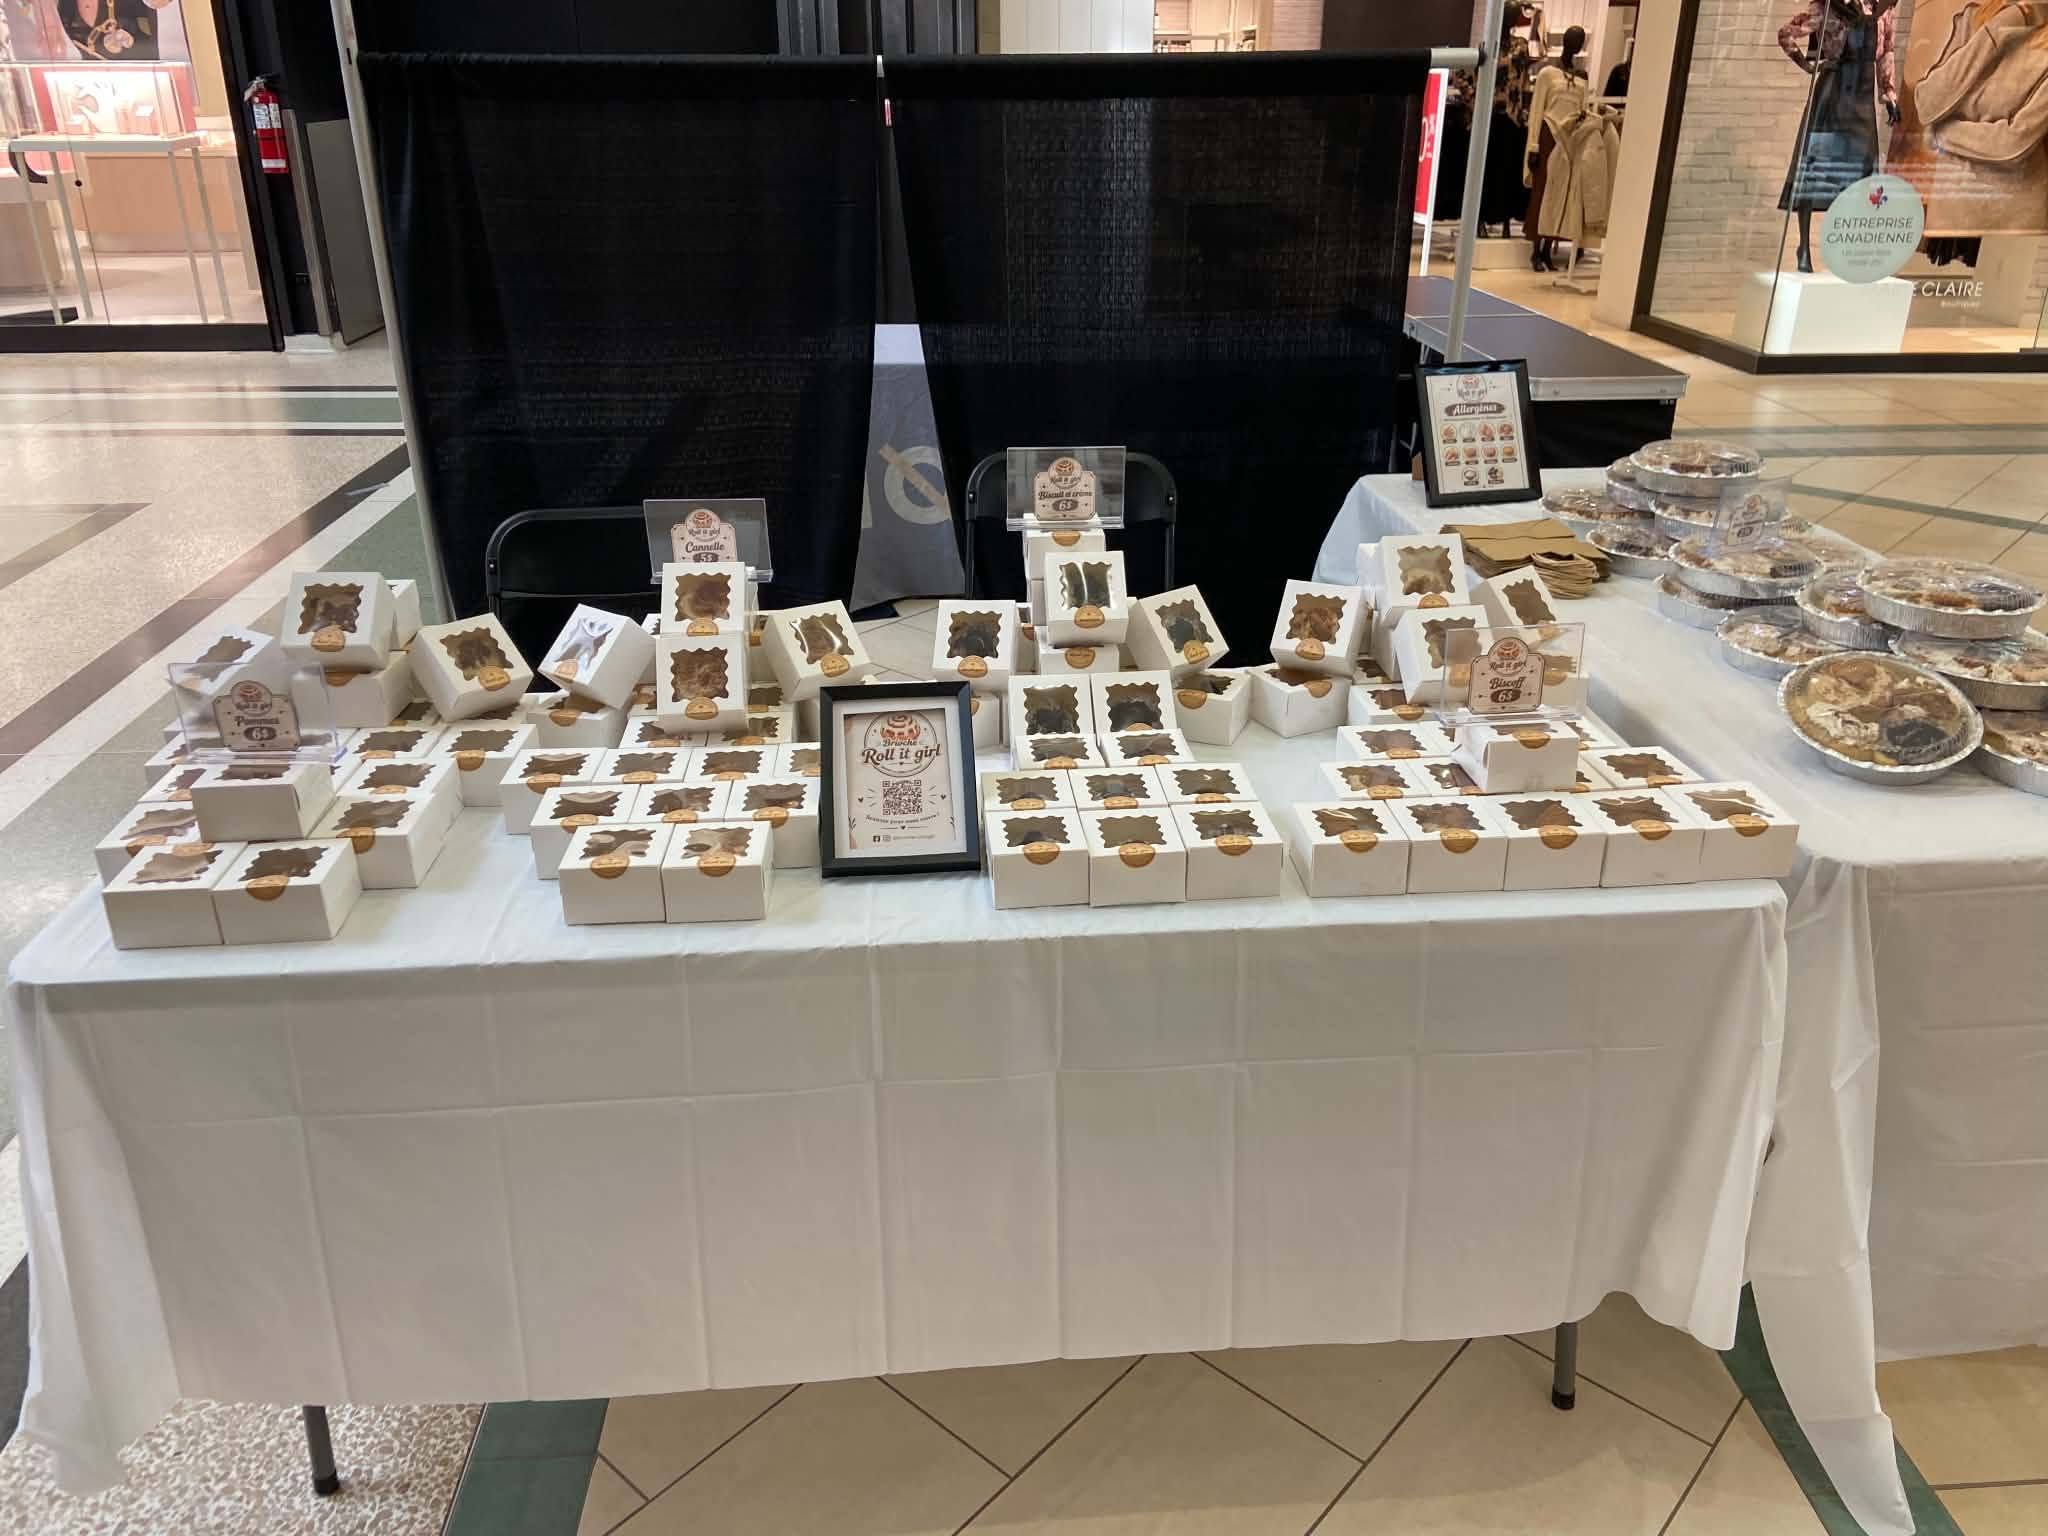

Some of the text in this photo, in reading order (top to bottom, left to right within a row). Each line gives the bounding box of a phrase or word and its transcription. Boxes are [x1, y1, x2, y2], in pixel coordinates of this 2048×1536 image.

[1833, 217, 1914, 229] ENTREPRISE
[1826, 232, 1914, 243] CANADIENNE
[1921, 280, 1985, 297] CLAIRE
[1038, 490, 1065, 500] Biscuit
[685, 541, 725, 553] Cannelle
[1488, 676, 1527, 690] Biscoff
[861, 743, 941, 766] Roll it girl
